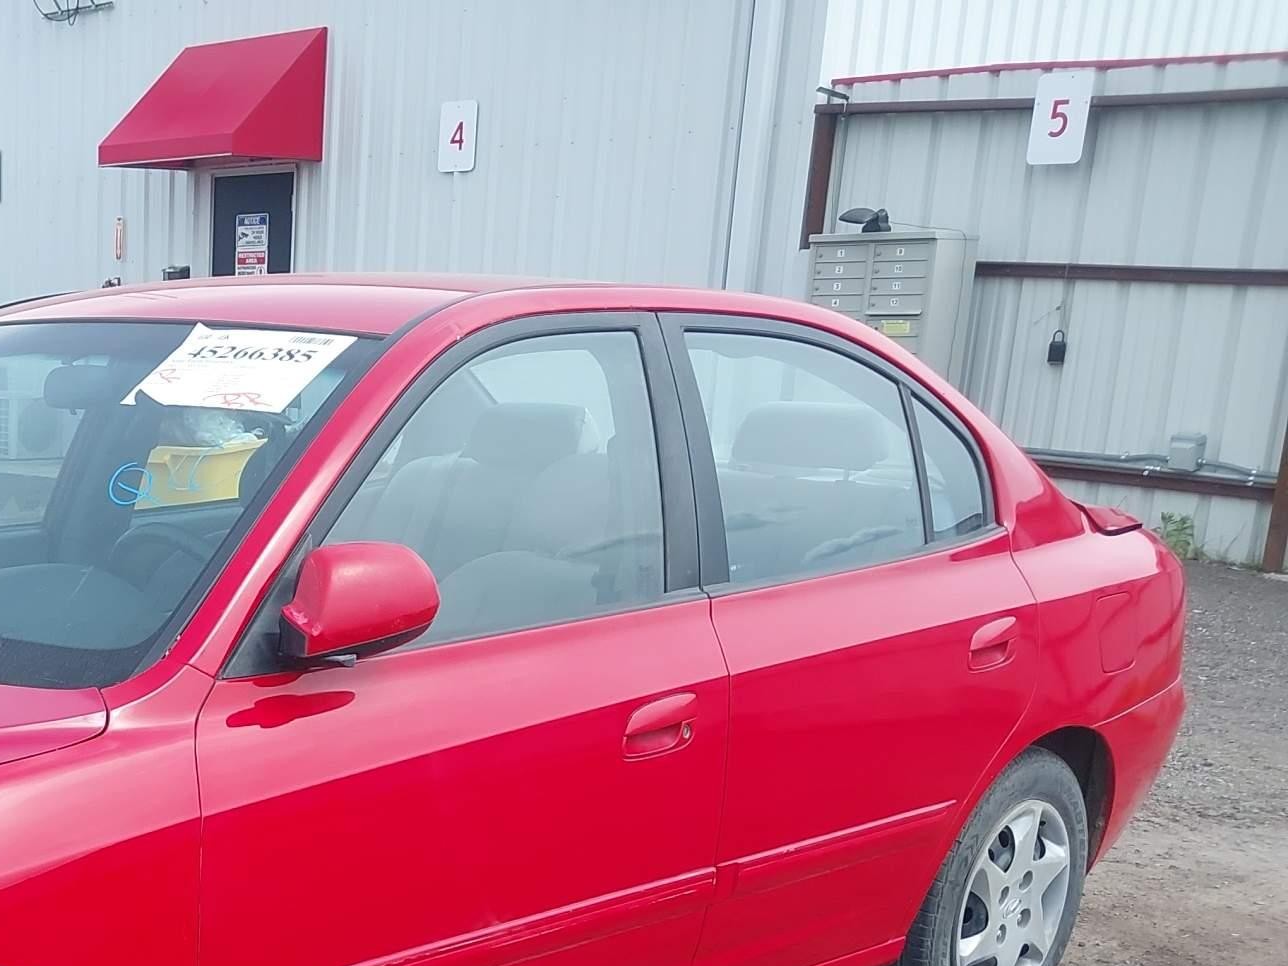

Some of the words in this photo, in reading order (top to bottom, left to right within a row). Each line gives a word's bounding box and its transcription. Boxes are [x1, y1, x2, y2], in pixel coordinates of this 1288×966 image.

[1048, 99, 1070, 138] 5
[449, 121, 464, 151] 4
[187, 344, 319, 363] 45266385
